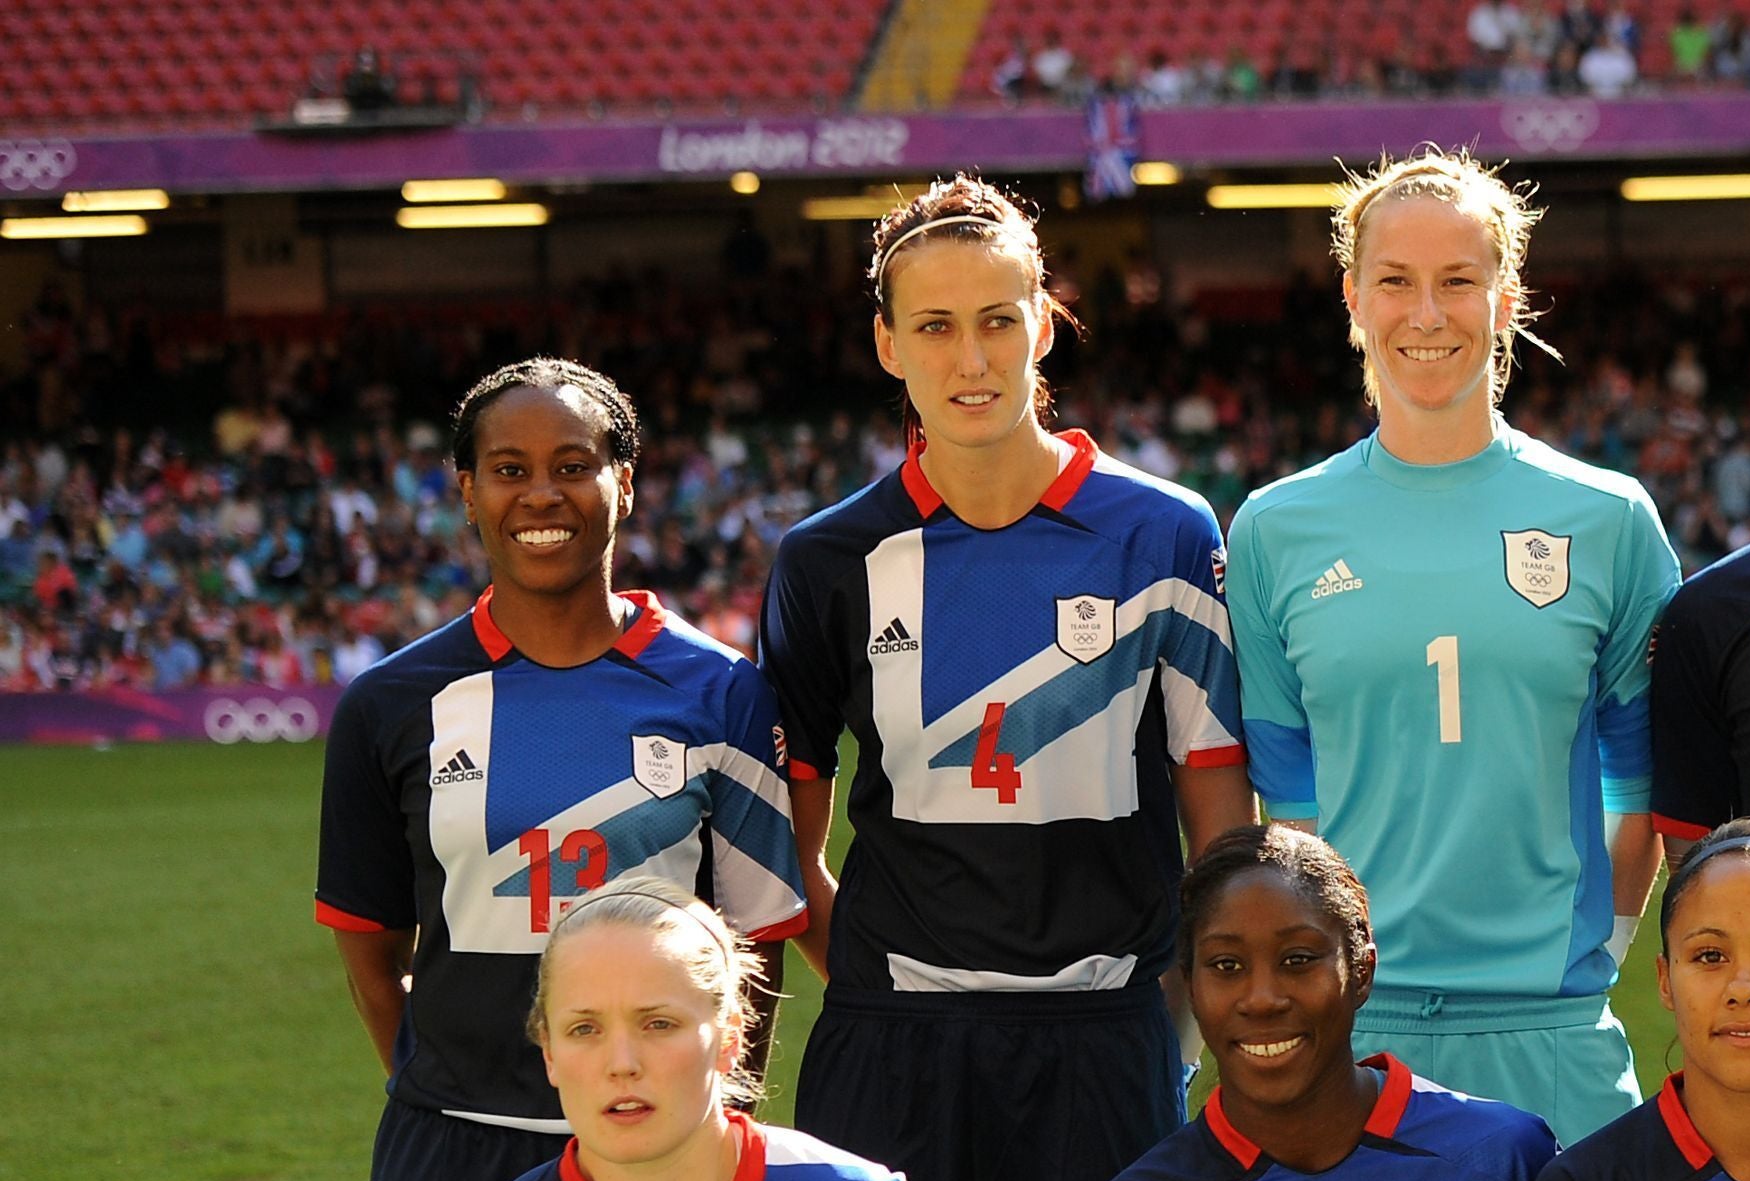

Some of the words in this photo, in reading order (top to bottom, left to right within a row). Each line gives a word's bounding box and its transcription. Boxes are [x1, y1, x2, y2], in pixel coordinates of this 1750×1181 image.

[659, 118, 809, 172] London
[812, 117, 910, 167] 2012
[1521, 561, 1542, 570] TEAM
[1544, 564, 1556, 572] GB
[1311, 576, 1363, 600] adidas
[870, 637, 919, 655] adidas
[1426, 636, 1461, 743] 1
[971, 702, 1022, 804] 4
[432, 768, 484, 786] adidas
[518, 828, 609, 933] 13
